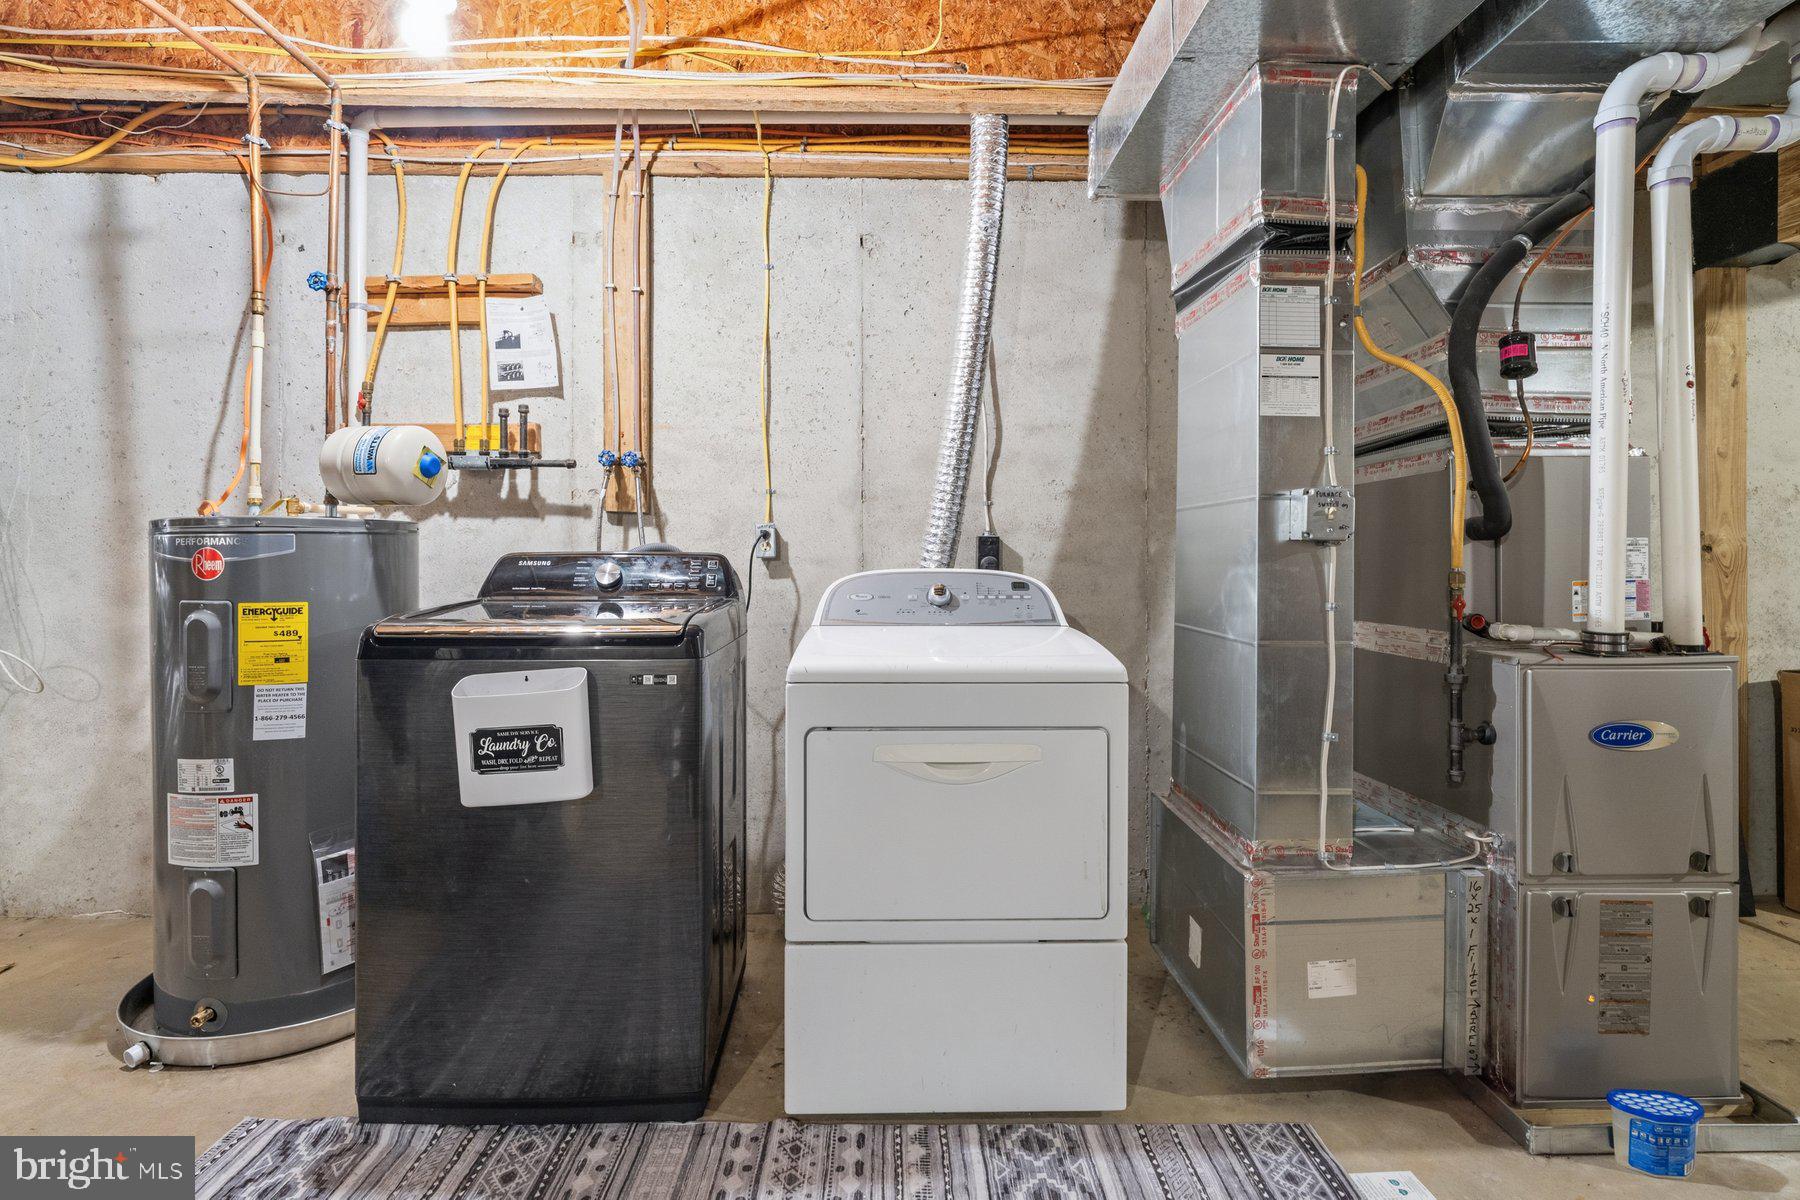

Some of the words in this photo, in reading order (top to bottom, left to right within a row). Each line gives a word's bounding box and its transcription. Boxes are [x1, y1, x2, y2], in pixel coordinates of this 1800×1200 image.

[1600, 353, 1608, 375] North
[1599, 377, 1608, 411] American
[1597, 413, 1607, 430] Pipe
[367, 436, 380, 460] WATTS
[195, 549, 223, 575] Rheem
[273, 629, 298, 637] $489
[1601, 729, 1646, 741] Carrier
[478, 736, 531, 757] Laundry
[1469, 881, 1481, 892] 16
[1467, 903, 1483, 913] 25
